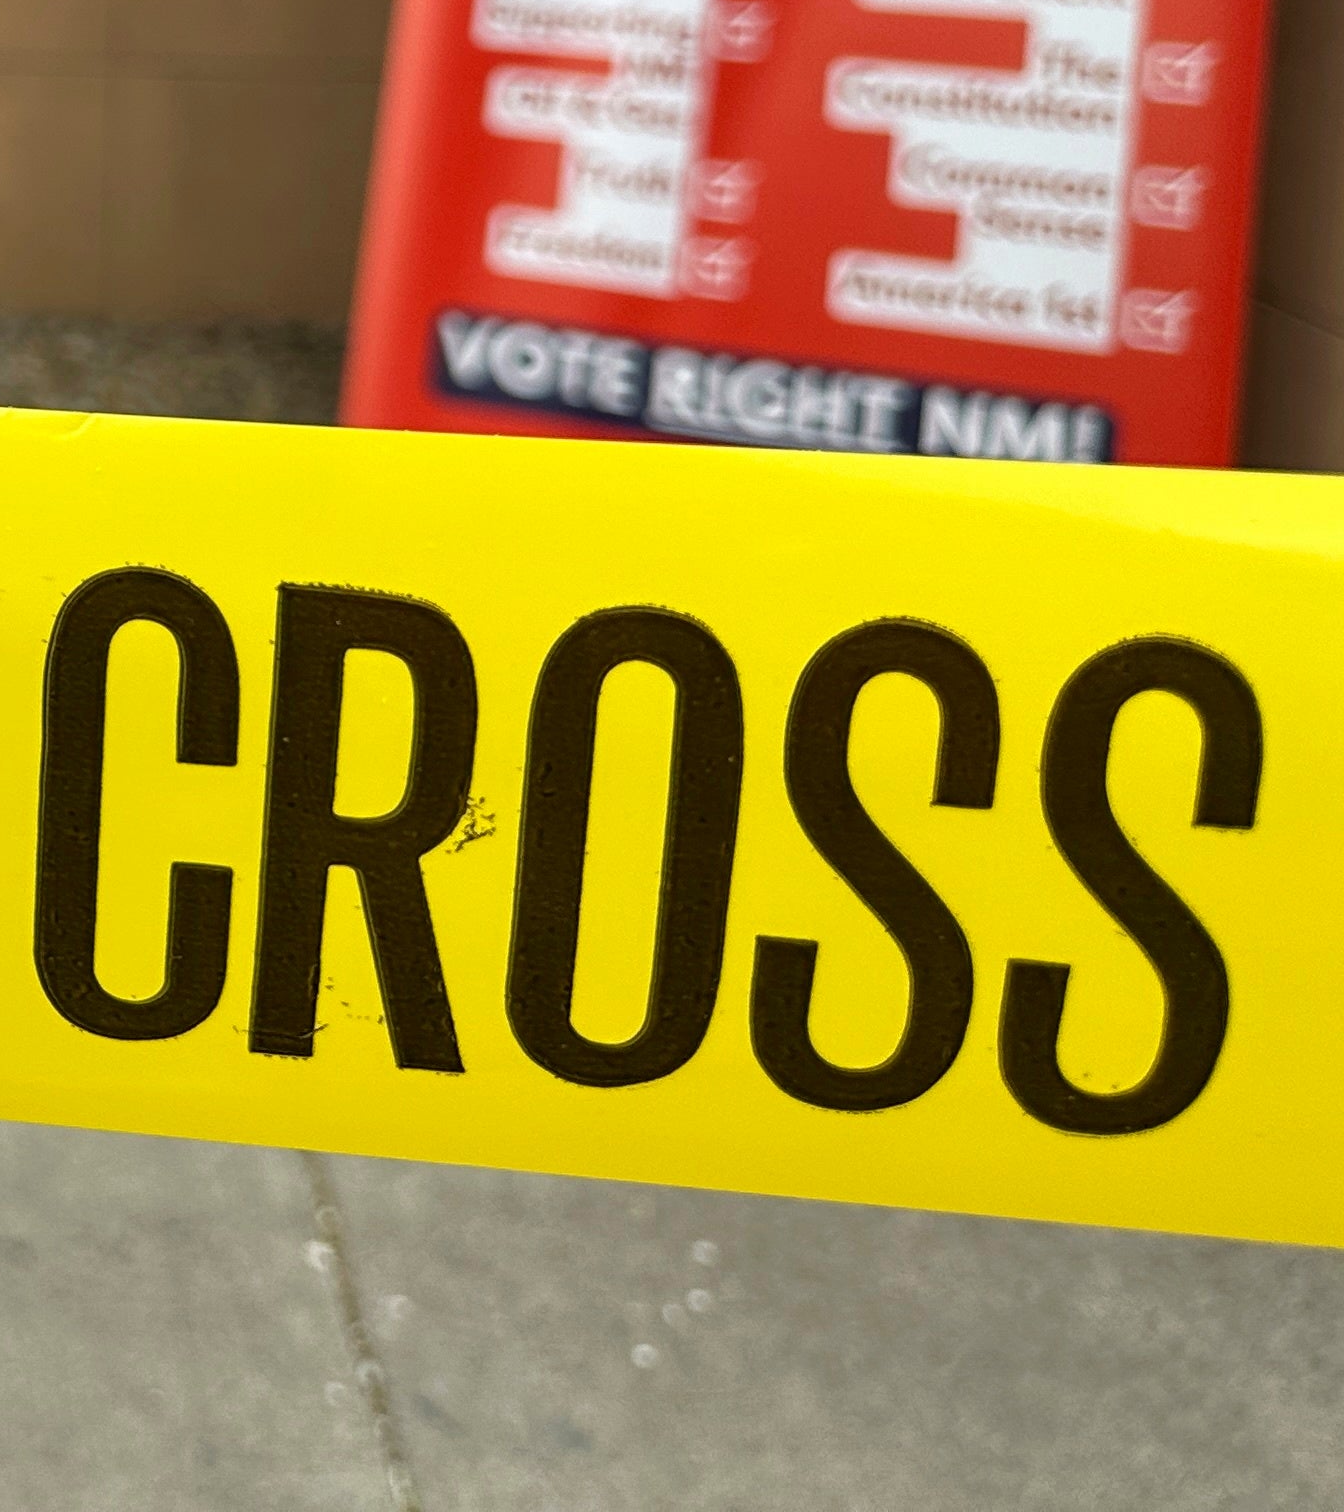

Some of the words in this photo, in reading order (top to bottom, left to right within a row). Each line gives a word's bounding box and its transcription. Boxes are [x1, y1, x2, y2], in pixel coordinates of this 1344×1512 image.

[1040, 40, 1120, 88] The
[837, 83, 1117, 136] Constitution
[898, 140, 1109, 204] Common
[972, 196, 1107, 244] Sense
[839, 267, 1027, 321] America
[436, 310, 641, 417] VOTE
[648, 346, 910, 450] RIGHT
[32, 563, 1265, 1137] CROSS
